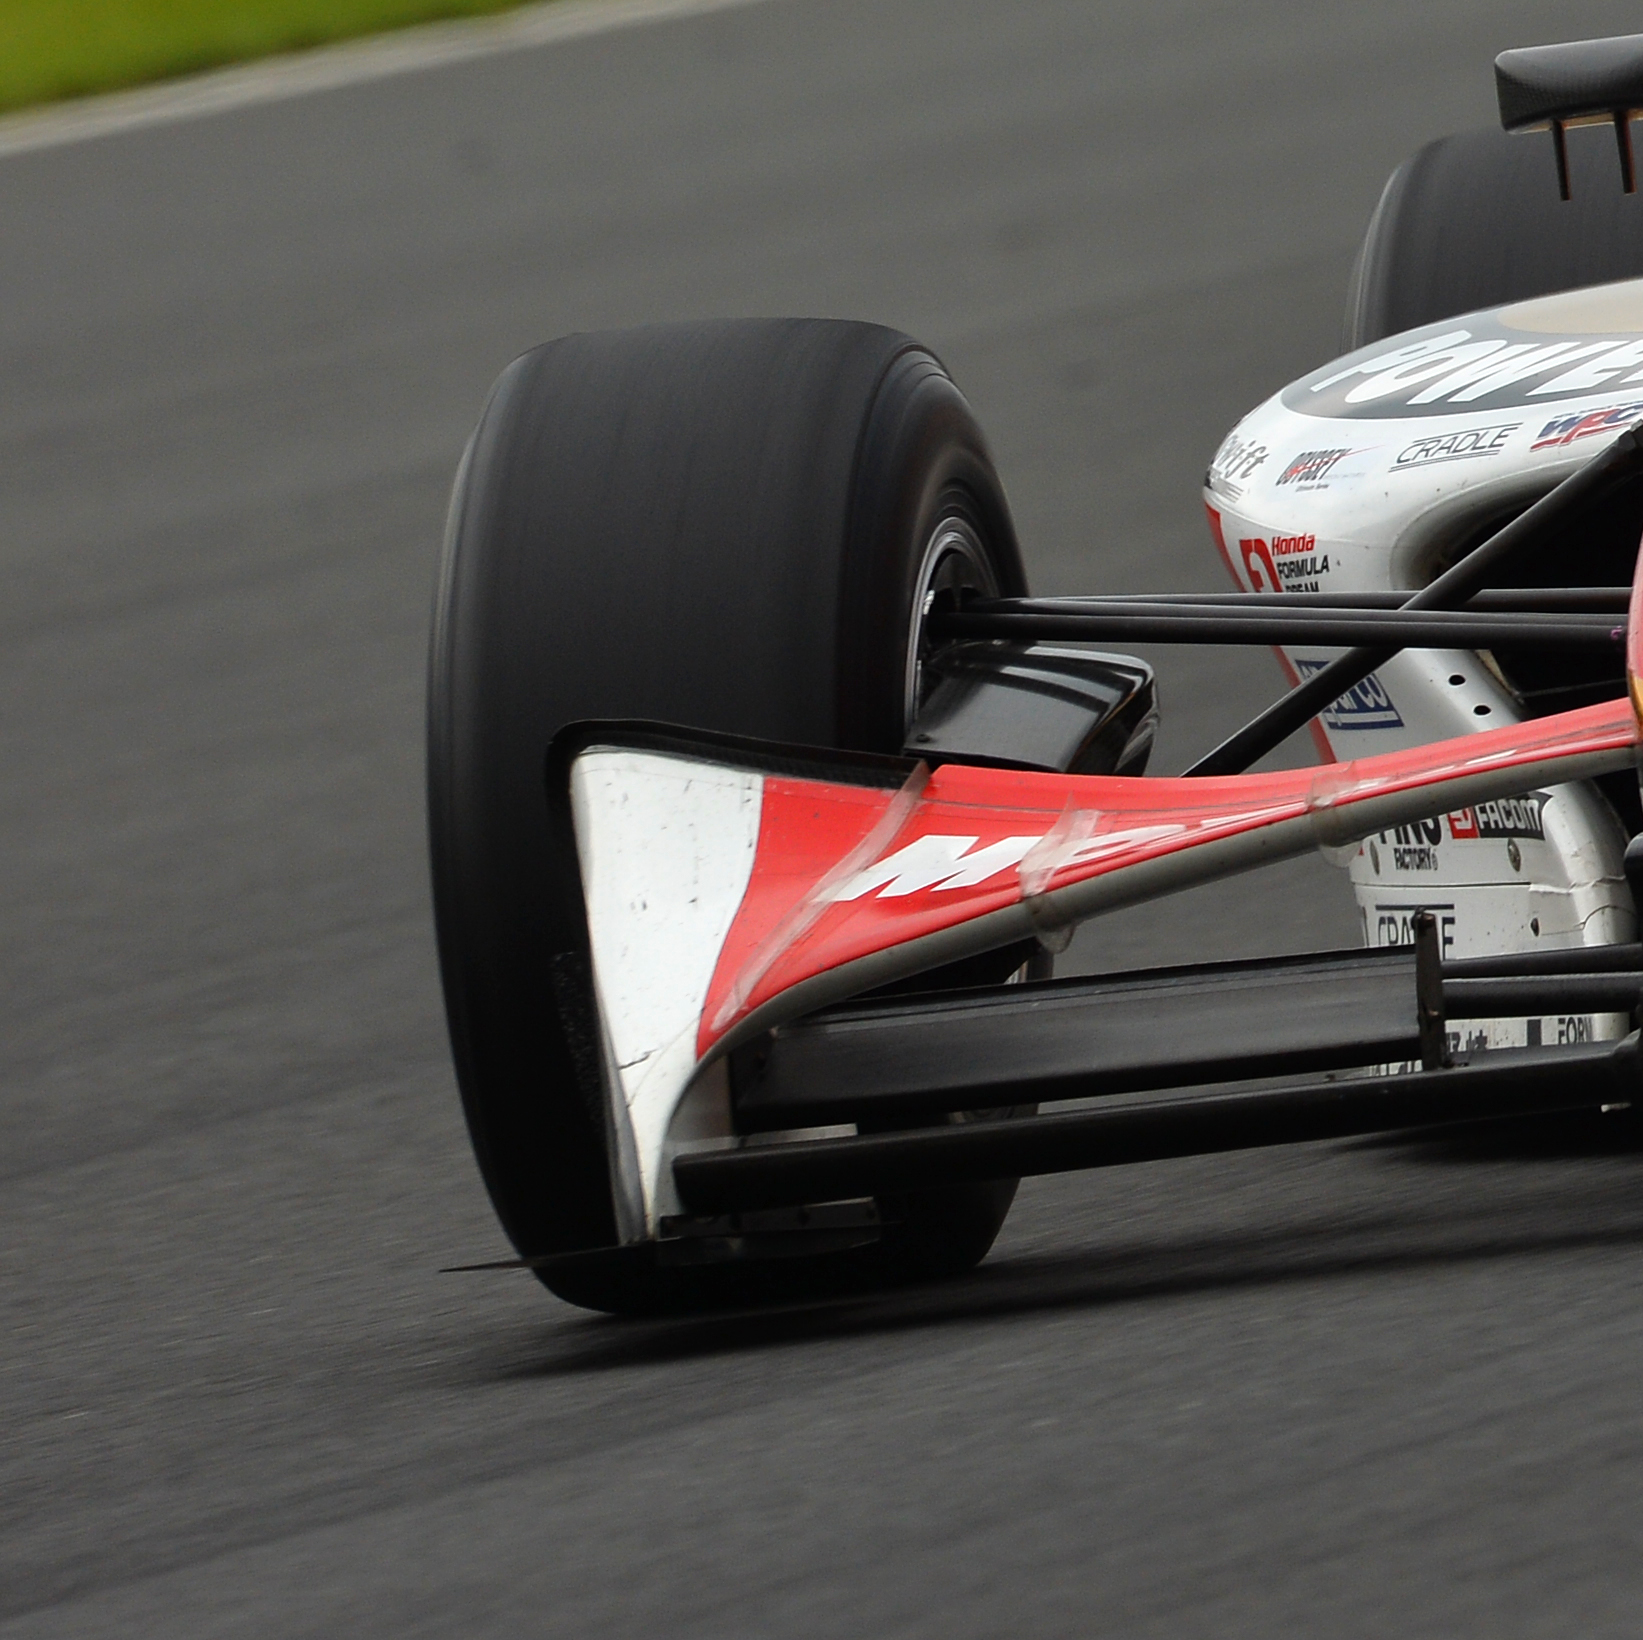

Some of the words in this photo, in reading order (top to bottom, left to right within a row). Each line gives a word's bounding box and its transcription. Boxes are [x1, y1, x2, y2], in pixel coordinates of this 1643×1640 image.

[1396, 426, 1519, 464] CRADLE
[1272, 533, 1316, 556] Honda
[1276, 554, 1330, 579] FORMULA
